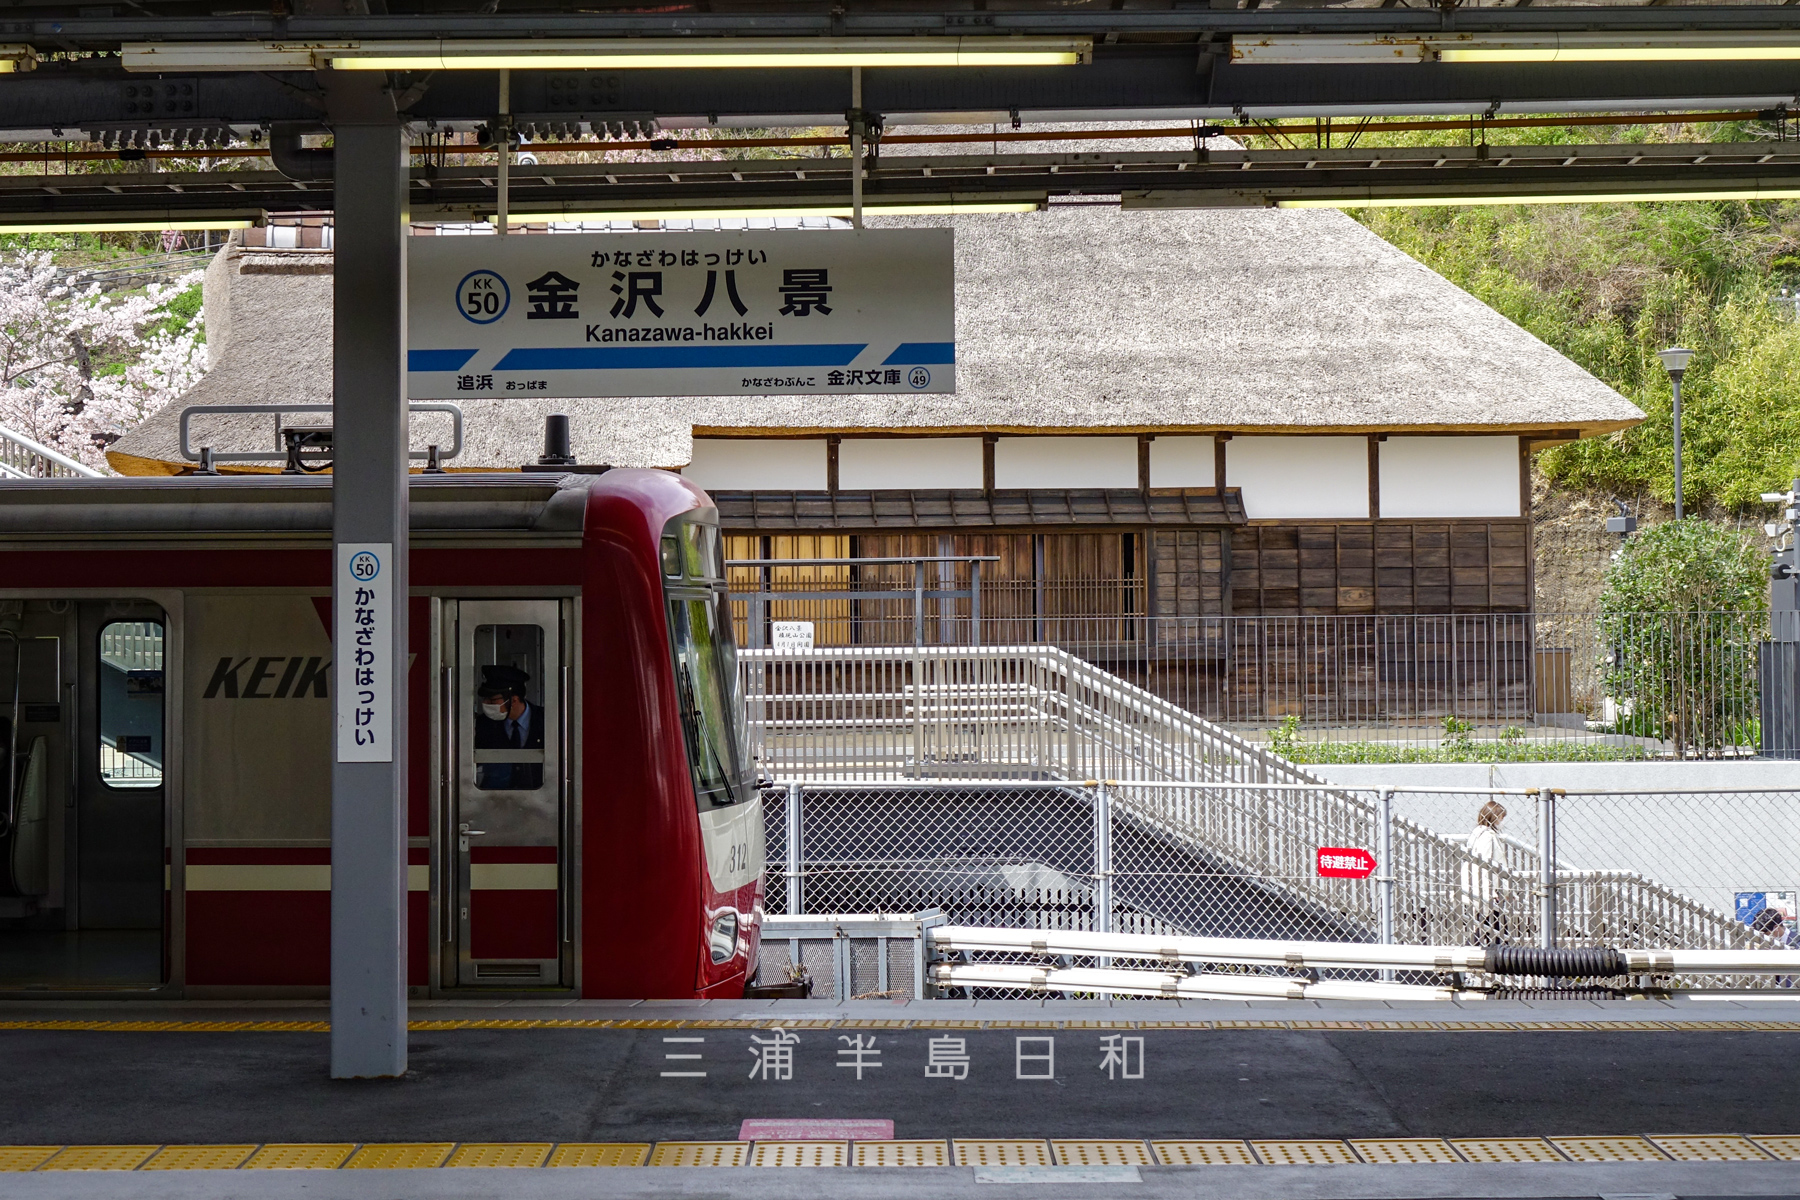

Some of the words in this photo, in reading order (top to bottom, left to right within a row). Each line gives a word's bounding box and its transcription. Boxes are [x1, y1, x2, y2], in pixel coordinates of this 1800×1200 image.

[591, 249, 767, 268] かなざわはっけい
[473, 278, 492, 290] KK
[467, 291, 499, 315] 50
[525, 268, 833, 320] 金沢八景
[585, 322, 773, 343] Kanazawa-hakkei
[457, 374, 493, 391] 追浜
[741, 376, 816, 388] かなざわぶんこ
[827, 369, 902, 387] 金沢文庫
[912, 375, 927, 386] 49
[356, 563, 374, 576] 50
[354, 587, 375, 745] かなざわはっけい
[202, 656, 333, 699] KEIK
[729, 843, 746, 873] 312
[1320, 855, 1369, 870] 待避禁止
